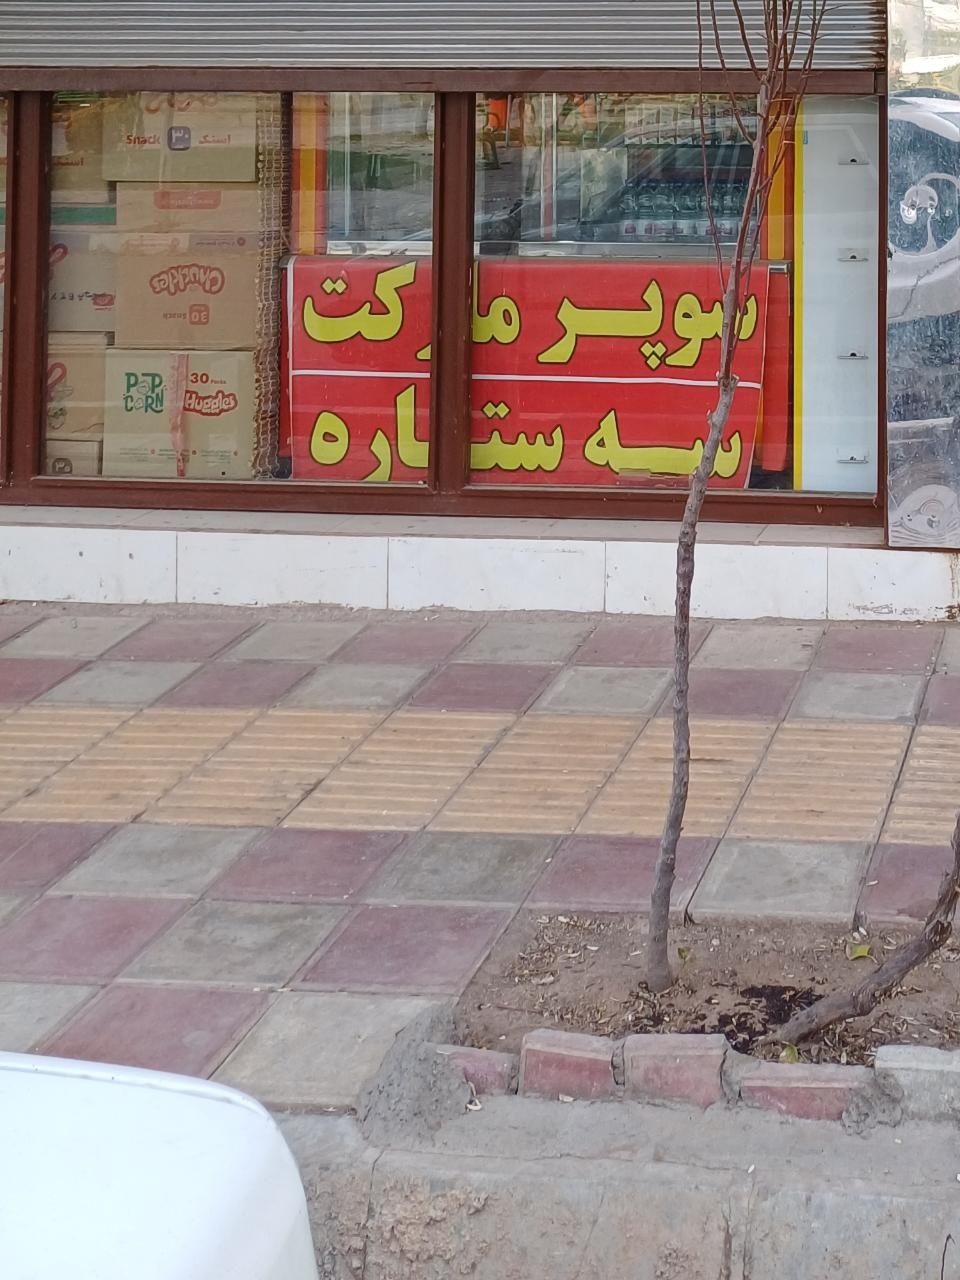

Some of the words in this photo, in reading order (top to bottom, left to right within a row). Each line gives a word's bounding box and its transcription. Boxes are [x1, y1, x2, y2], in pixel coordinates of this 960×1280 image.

[536, 278, 758, 371] سوپر
[190, 372, 209, 384] 30
[309, 383, 563, 482] ستاره
